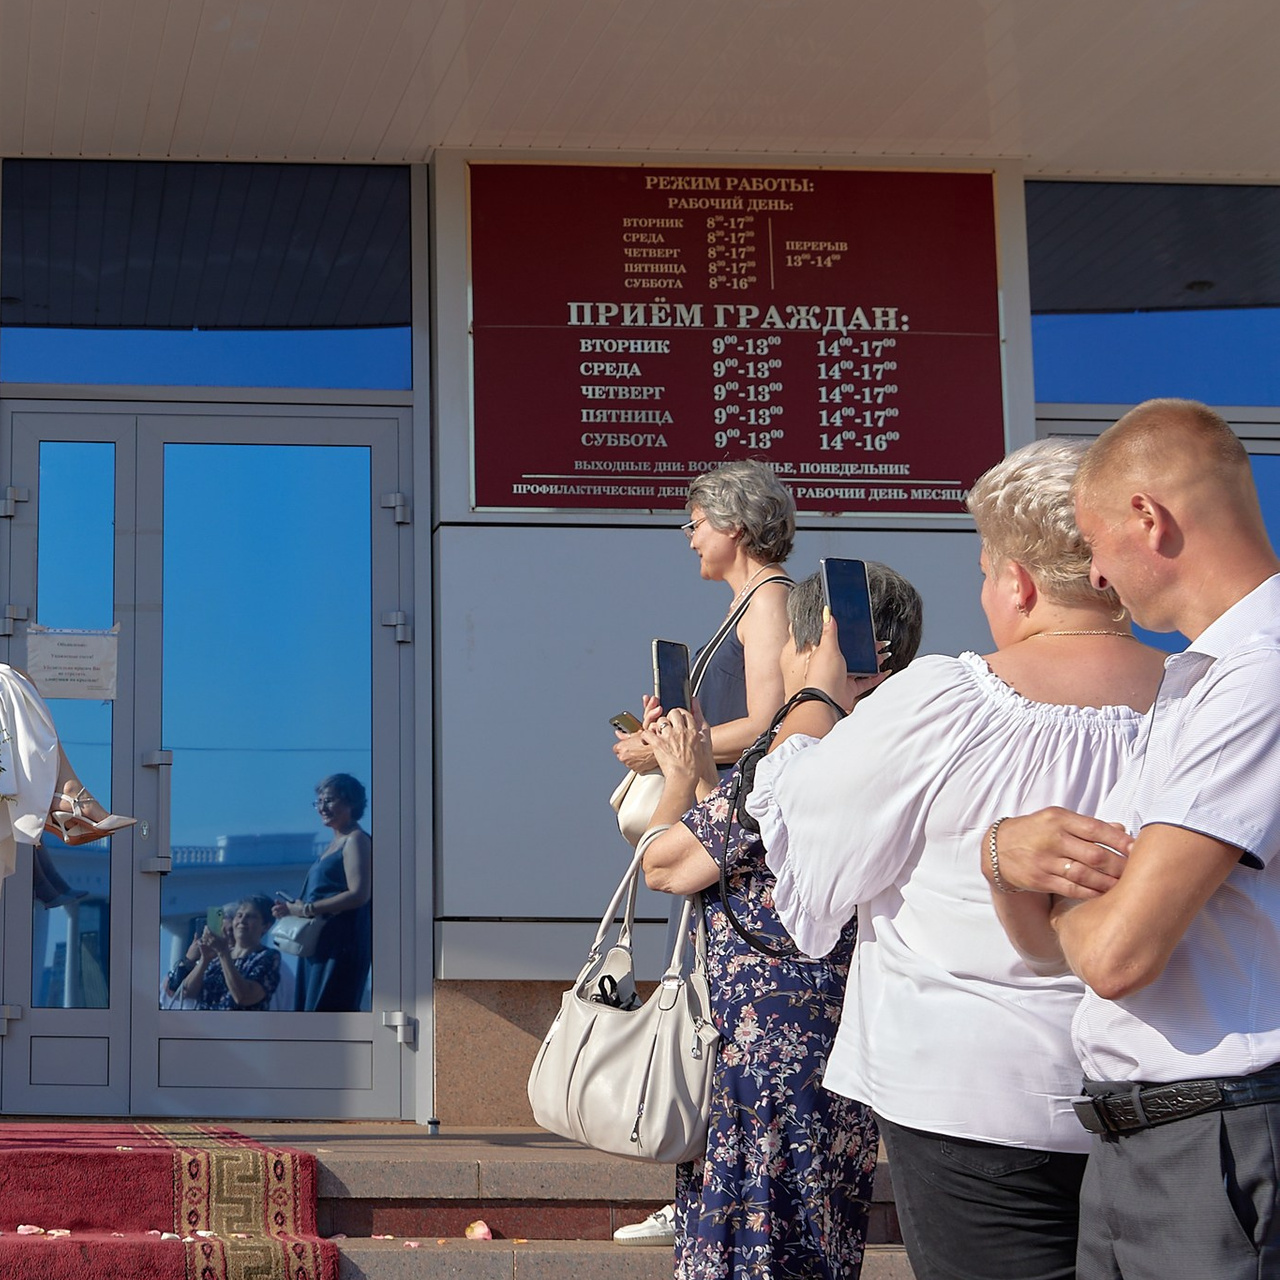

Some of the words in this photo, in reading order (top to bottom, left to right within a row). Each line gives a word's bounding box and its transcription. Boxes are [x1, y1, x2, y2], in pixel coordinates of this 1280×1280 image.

[645, 176, 721, 190] РЕЖИМ
[726, 177, 814, 192] РАБОТЫ:
[669, 196, 743, 210] РАБОЧИЙ
[747, 199, 794, 211] ДЕНЬ:
[623, 219, 684, 228] ВТОРНИК
[623, 233, 665, 243] СРЕДА
[624, 249, 681, 258] ЧЕТВЕРГ
[786, 241, 848, 251] ПЕРЕРЫВ
[624, 264, 687, 273] ПЯТНИЦА
[625, 279, 683, 288] СУББОТА
[567, 297, 705, 329] ПРИЁМ
[714, 305, 911, 336] ГРАЖДАН:
[579, 338, 671, 356] ВТОРНИК
[580, 362, 643, 380] СРЕДА
[580, 385, 666, 401] ЧЕТВЕРГ
[580, 408, 674, 427] ПЯТНИЦА
[580, 432, 669, 449] СУББОТА
[574, 460, 652, 474] ВЫХОДНЫЕ
[653, 461, 686, 475] ДНИ:
[799, 463, 910, 477] ПОНЕДЕЛЬНИК
[868, 487, 910, 501] ДЕНЬ
